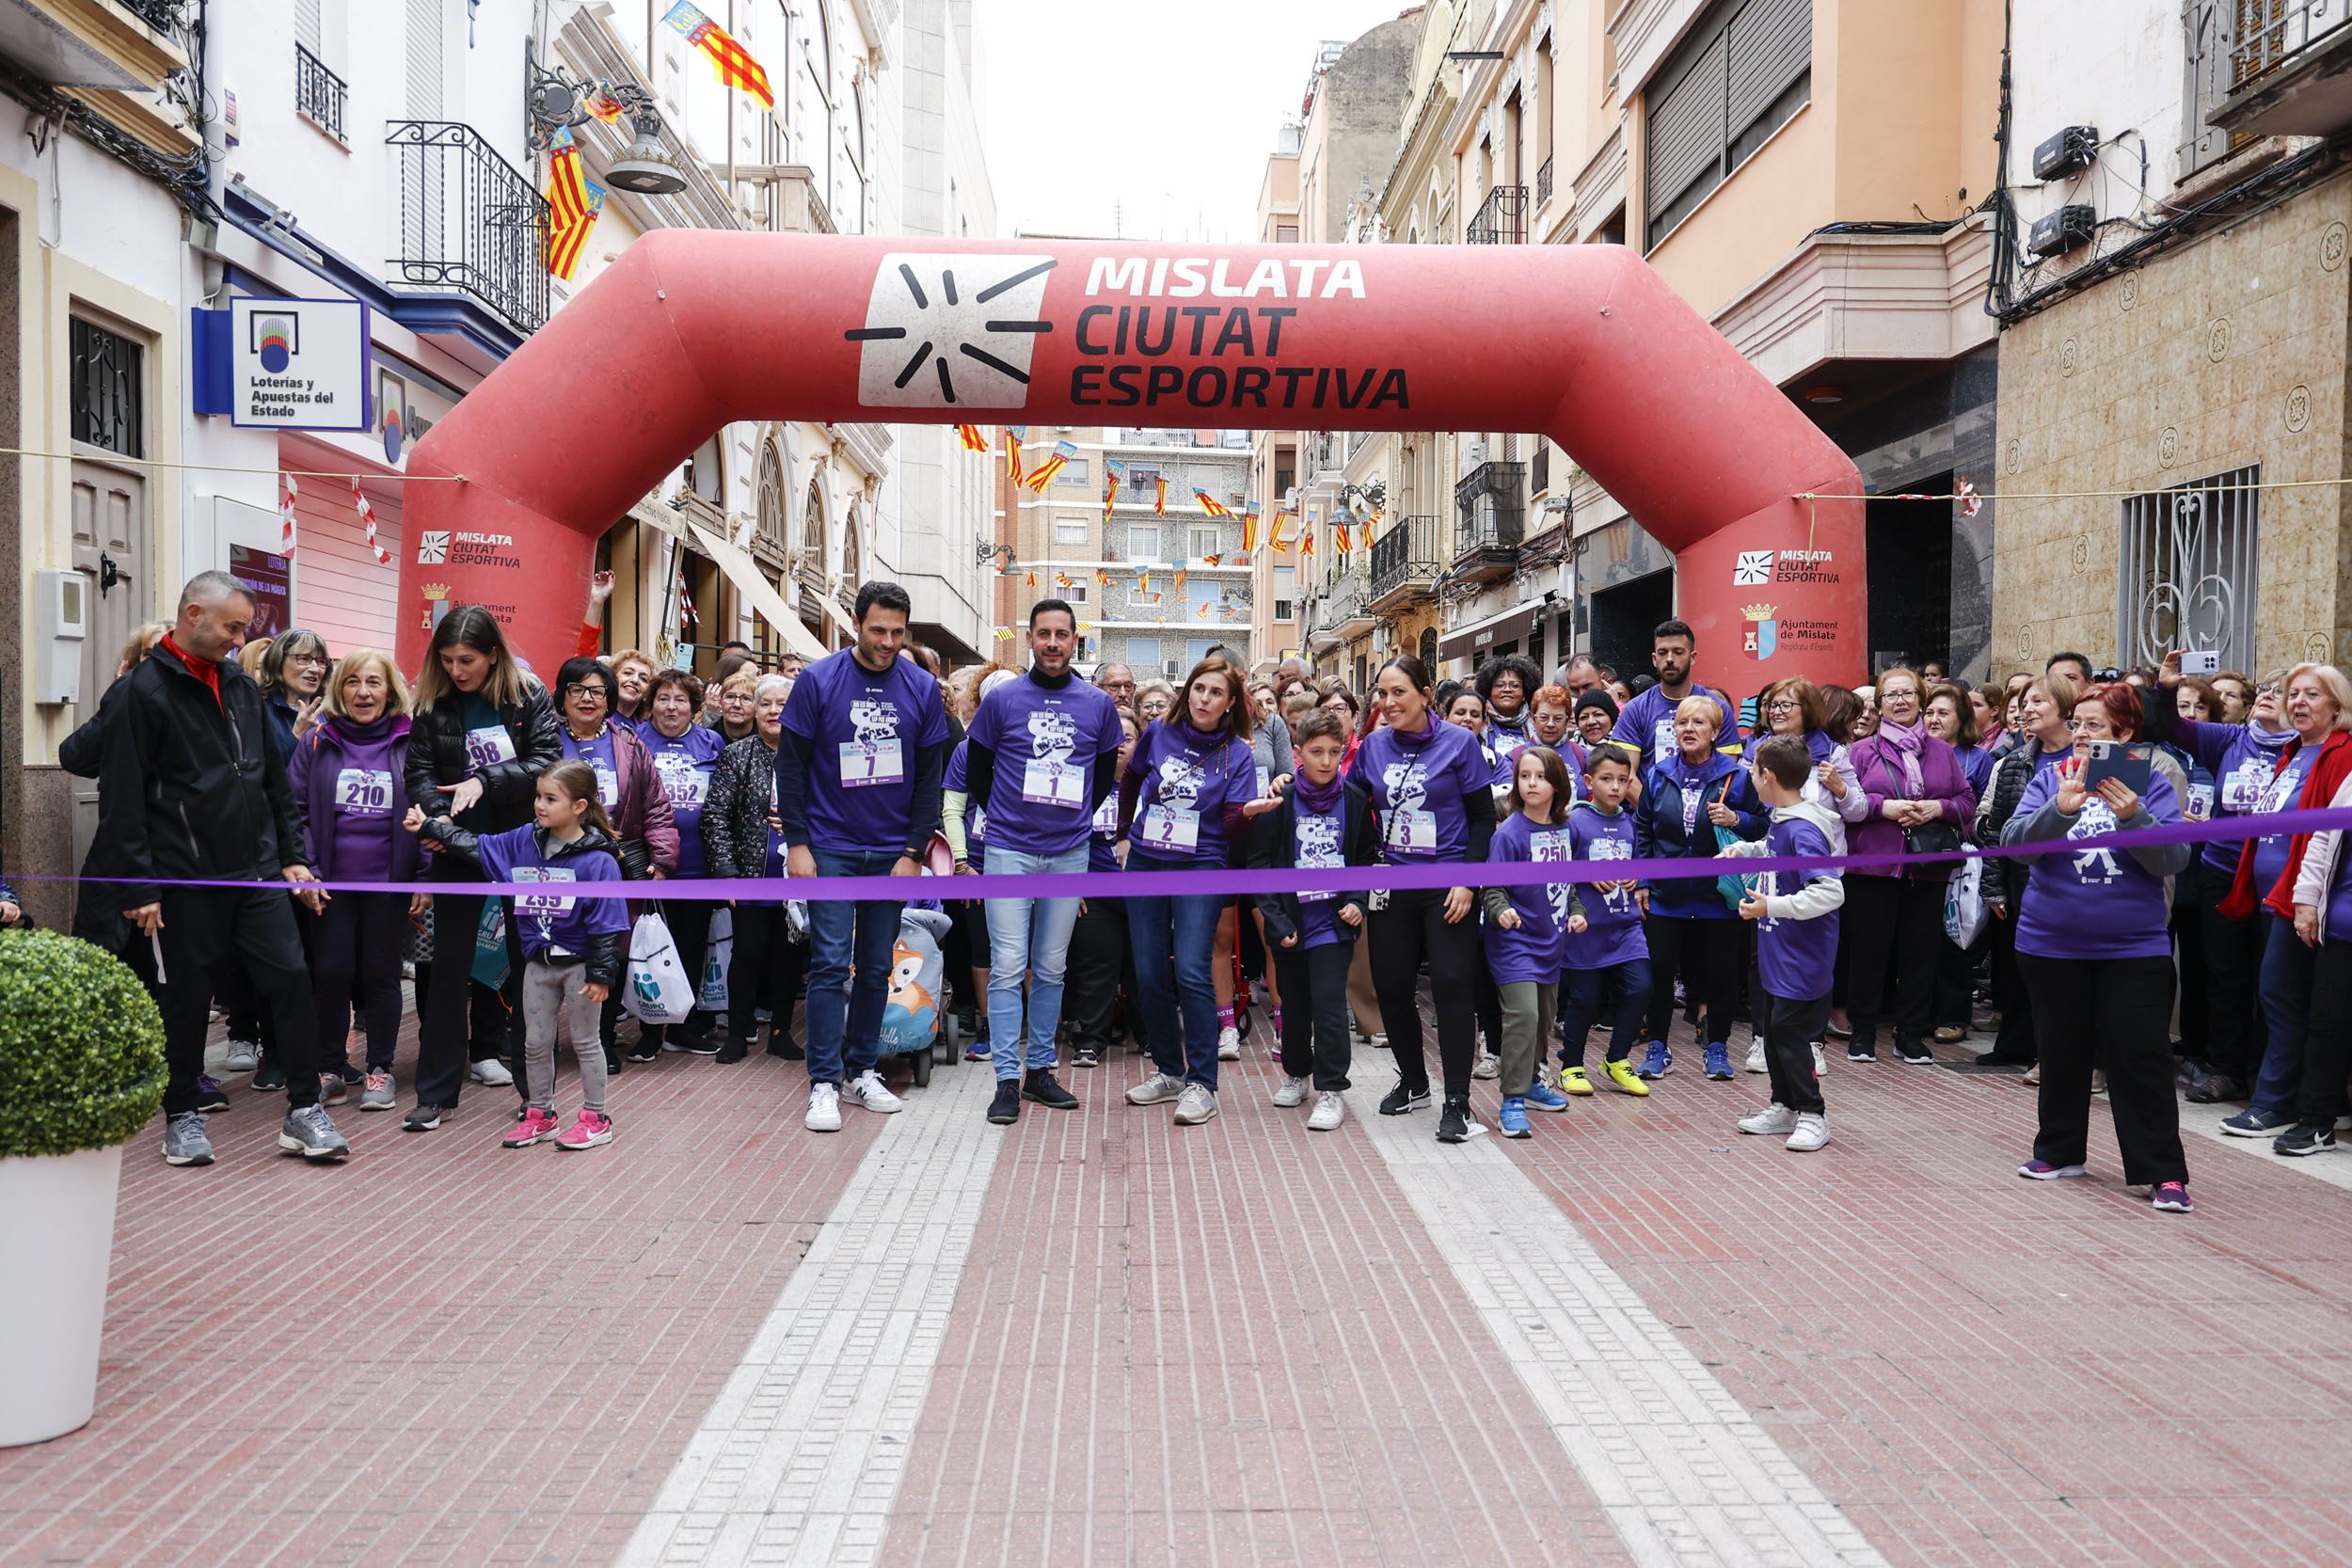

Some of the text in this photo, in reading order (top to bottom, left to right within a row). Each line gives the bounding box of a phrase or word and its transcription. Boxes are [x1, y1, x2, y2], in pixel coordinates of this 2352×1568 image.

[1084, 257, 1367, 299] MISLATA
[1074, 305, 1297, 357] CIUTAT
[251, 375, 314, 391] Loterías y
[1069, 365, 1410, 410] ESPORTIVA
[251, 390, 334, 404] Apuestas del
[251, 404, 295, 417] Estado
[455, 531, 513, 546] MISLATA
[453, 542, 498, 555] CIUTAT
[1780, 549, 1833, 562] MISLATA
[451, 553, 520, 568] ESPORTIVA
[1778, 561, 1821, 572] CIUTAT
[1776, 572, 1840, 584] ESPORTIVA
[1780, 619, 1838, 630] Ajuntament
[1797, 629, 1836, 640] Mislata
[865, 756, 875, 776] 7
[345, 782, 386, 807] 210
[665, 783, 698, 801] 352
[1049, 777, 1058, 797] 1
[1161, 821, 1174, 842] 2
[1400, 824, 1411, 846] 3
[1539, 845, 1567, 863] 250
[477, 929, 504, 943] GRUO
[879, 1026, 898, 1045] Hello
